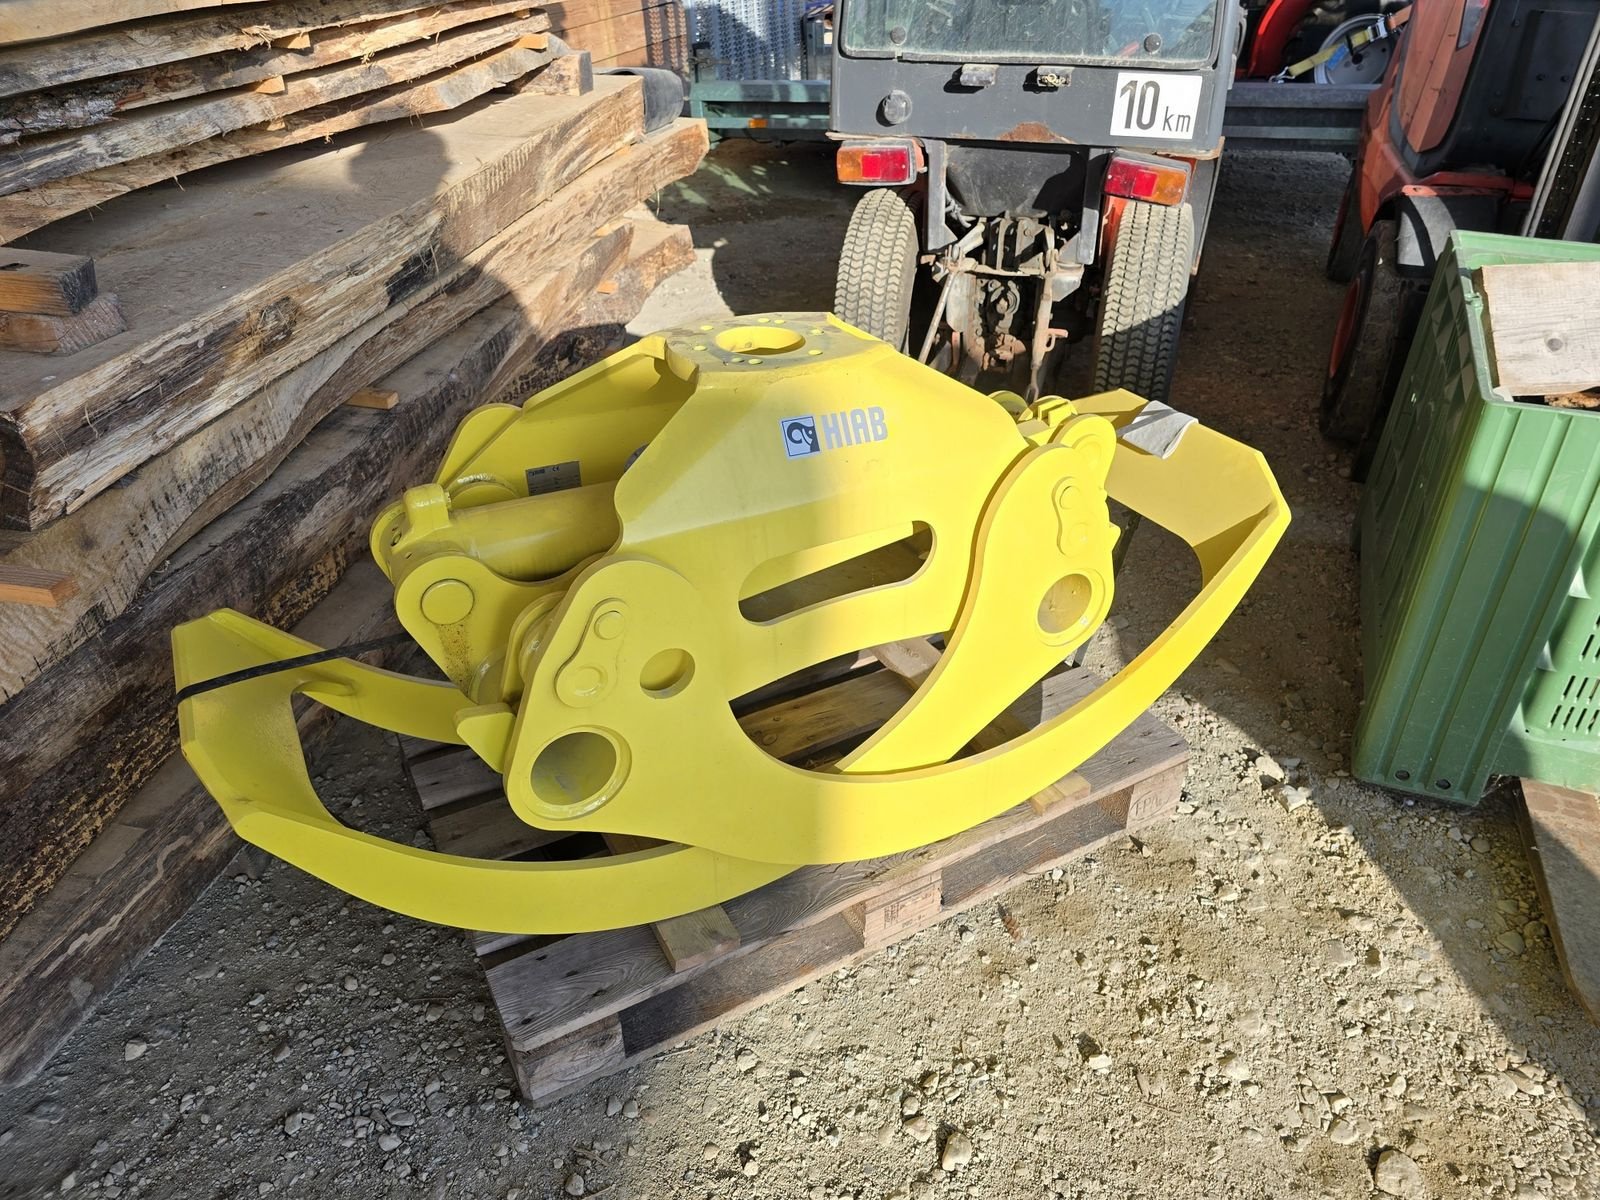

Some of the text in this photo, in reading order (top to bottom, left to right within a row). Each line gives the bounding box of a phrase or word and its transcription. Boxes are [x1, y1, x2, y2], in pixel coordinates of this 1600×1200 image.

[1119, 80, 1191, 132] 10 km
[820, 406, 888, 449] HIAB
